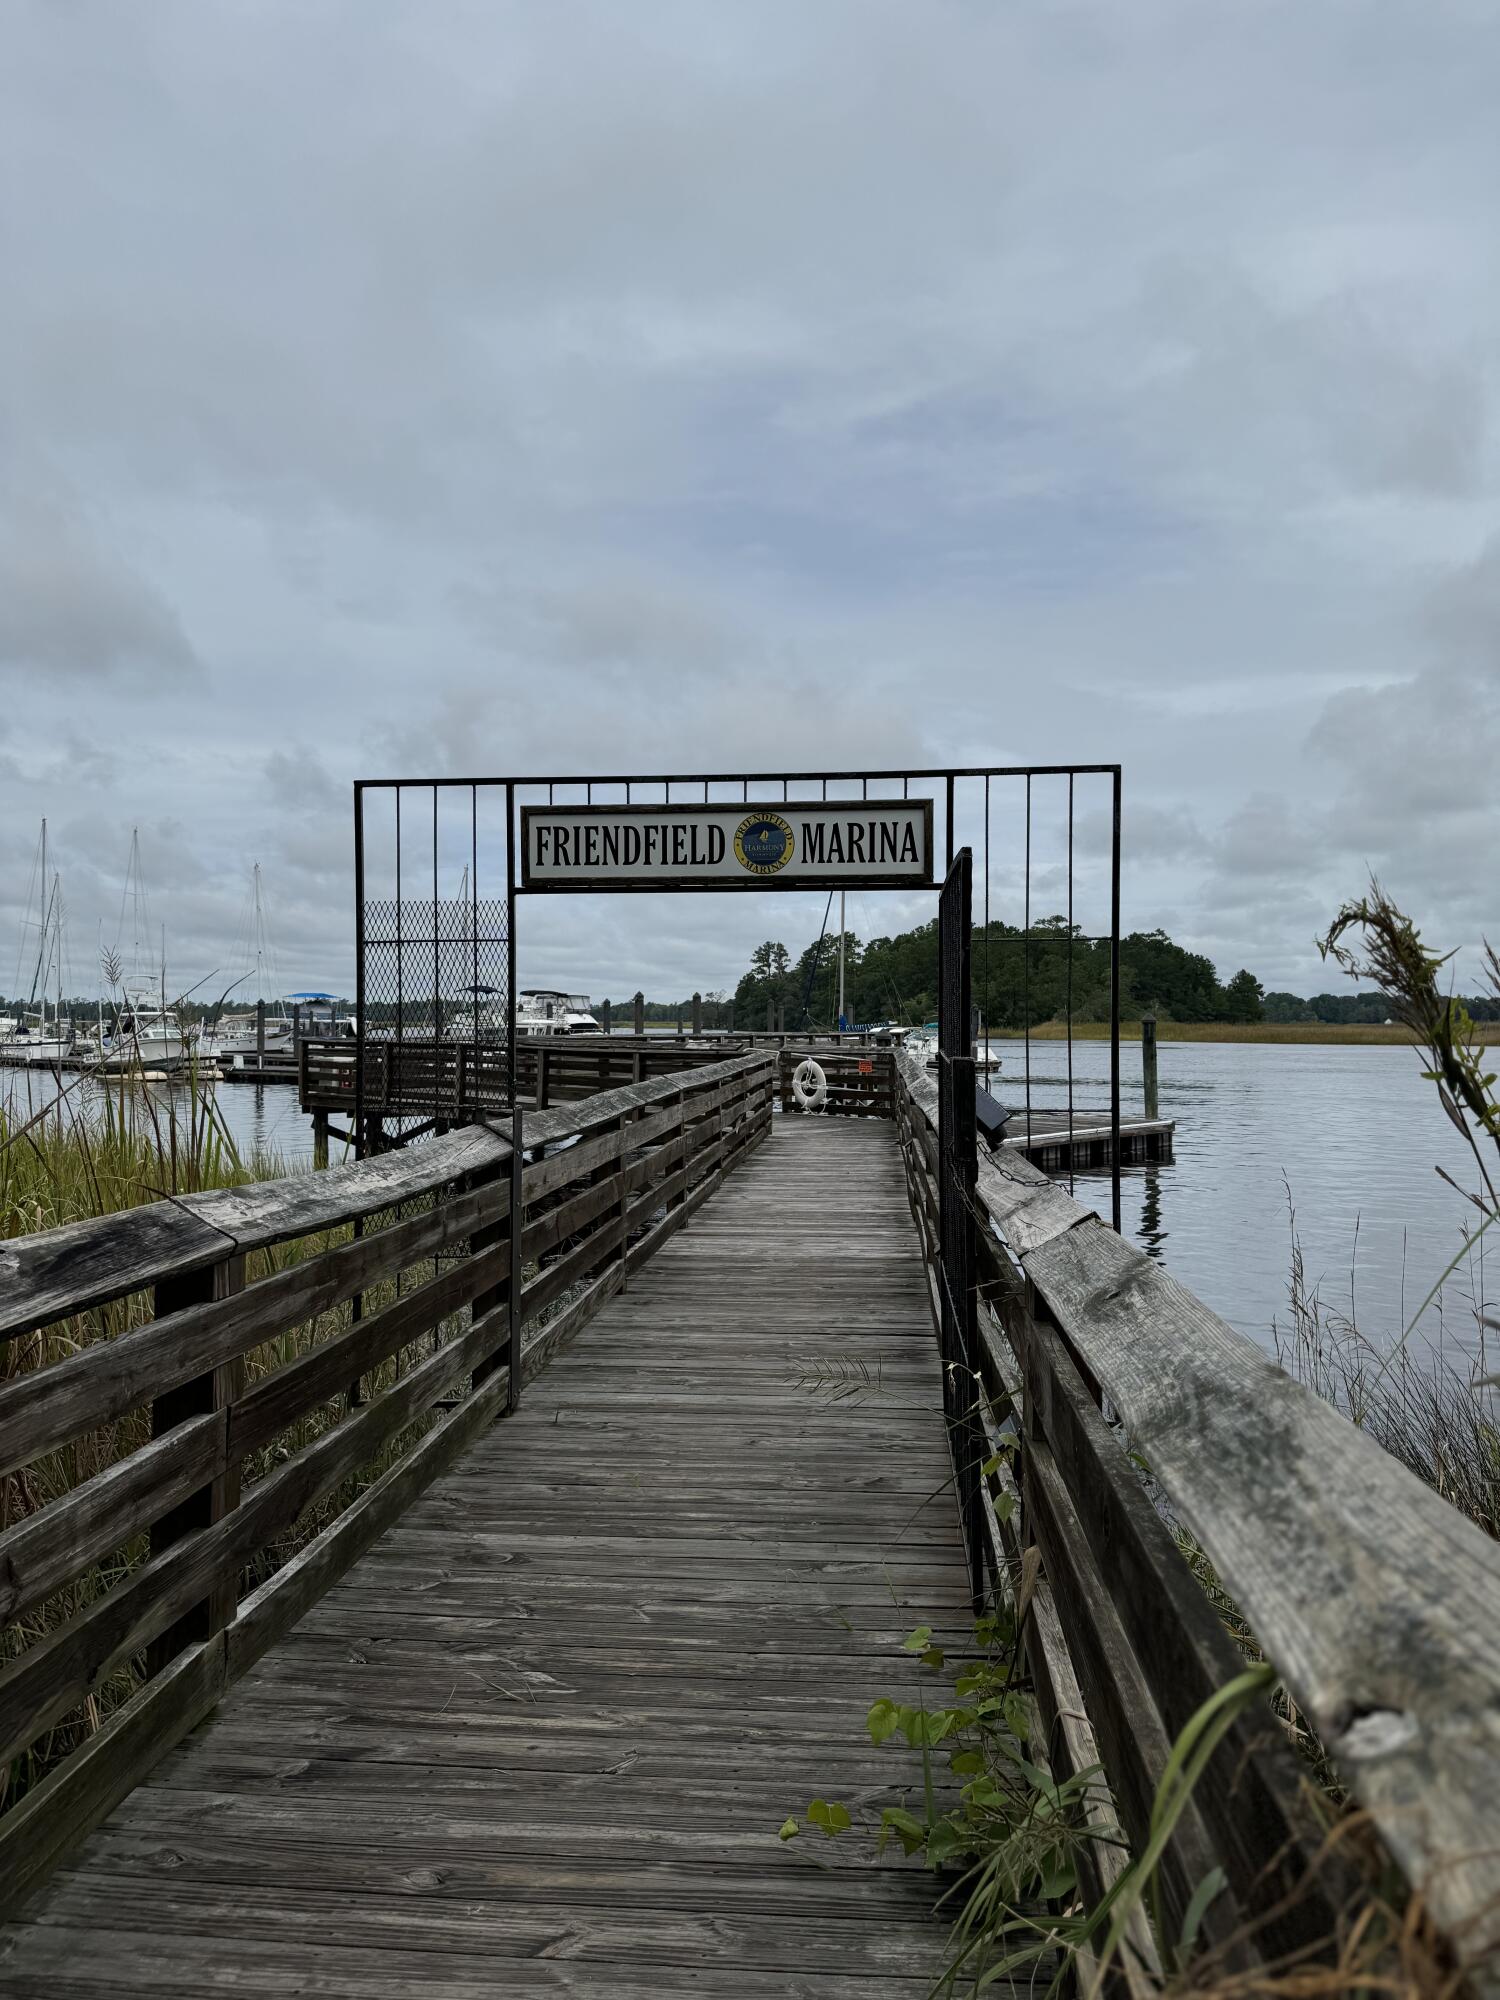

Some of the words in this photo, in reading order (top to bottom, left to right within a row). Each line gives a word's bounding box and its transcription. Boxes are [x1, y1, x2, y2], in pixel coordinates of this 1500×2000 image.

[736, 813, 793, 840] FRIENDFIELD
[536, 825, 726, 866] FRIENDFIELD
[801, 821, 919, 863] MARINA
[745, 861, 785, 874] MARINA
